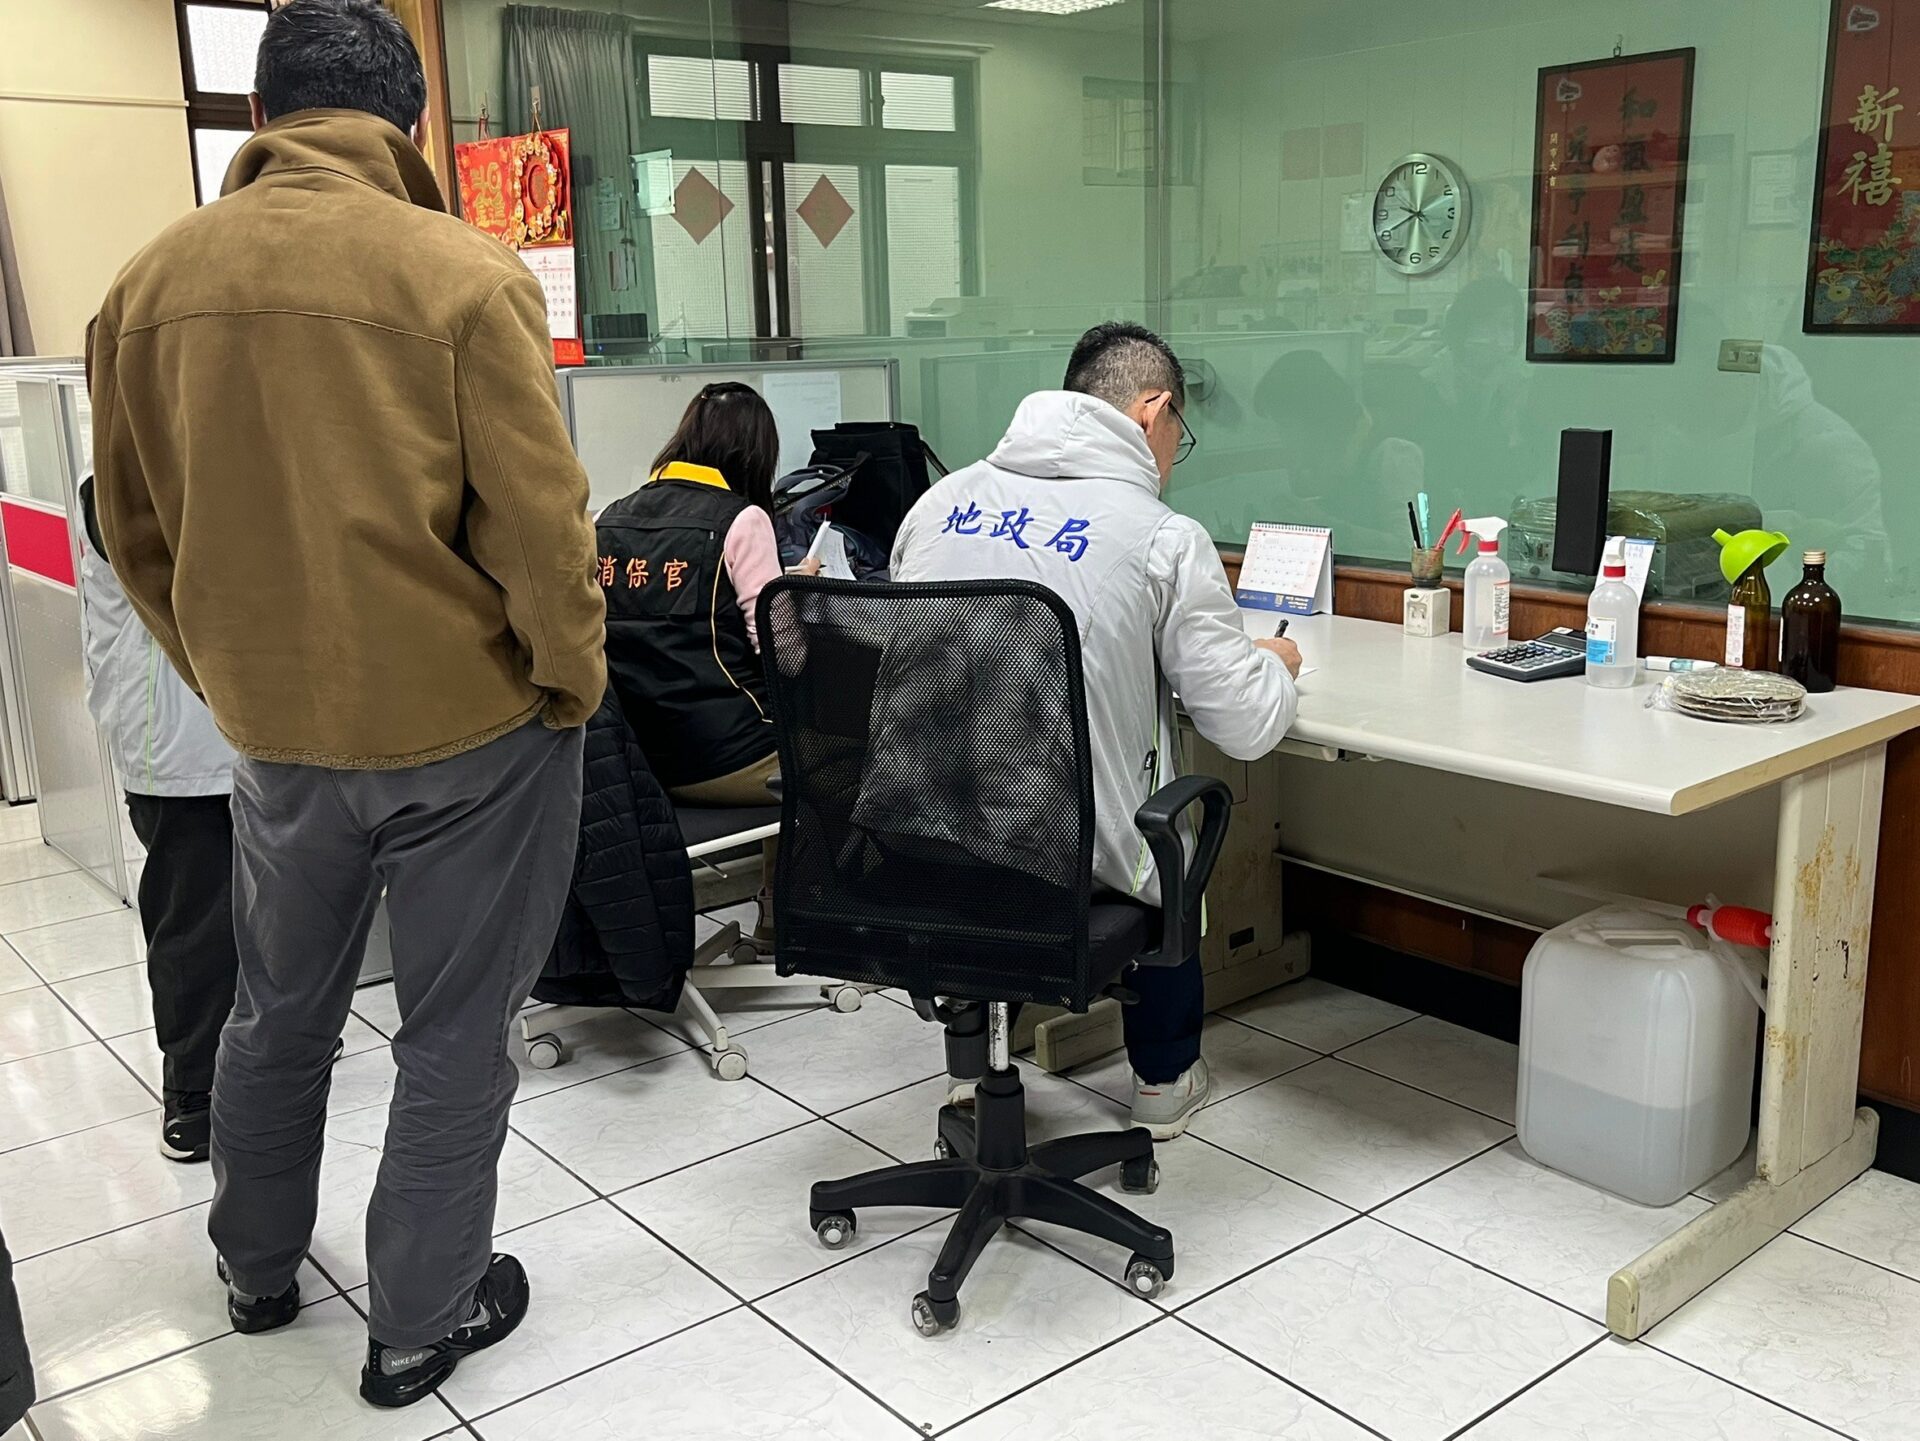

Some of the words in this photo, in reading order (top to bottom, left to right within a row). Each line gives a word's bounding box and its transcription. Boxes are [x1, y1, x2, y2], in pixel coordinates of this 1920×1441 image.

[1837, 85, 1904, 206] 新禧
[1411, 163, 1428, 175] 12
[1378, 209, 1389, 220] 9
[1380, 229, 1392, 241] 8
[1409, 252, 1422, 264] 6
[1428, 246, 1440, 258] 5
[941, 500, 1090, 562] 地政局
[597, 555, 689, 592] 消保官
[391, 1356, 410, 1367] NIKE
